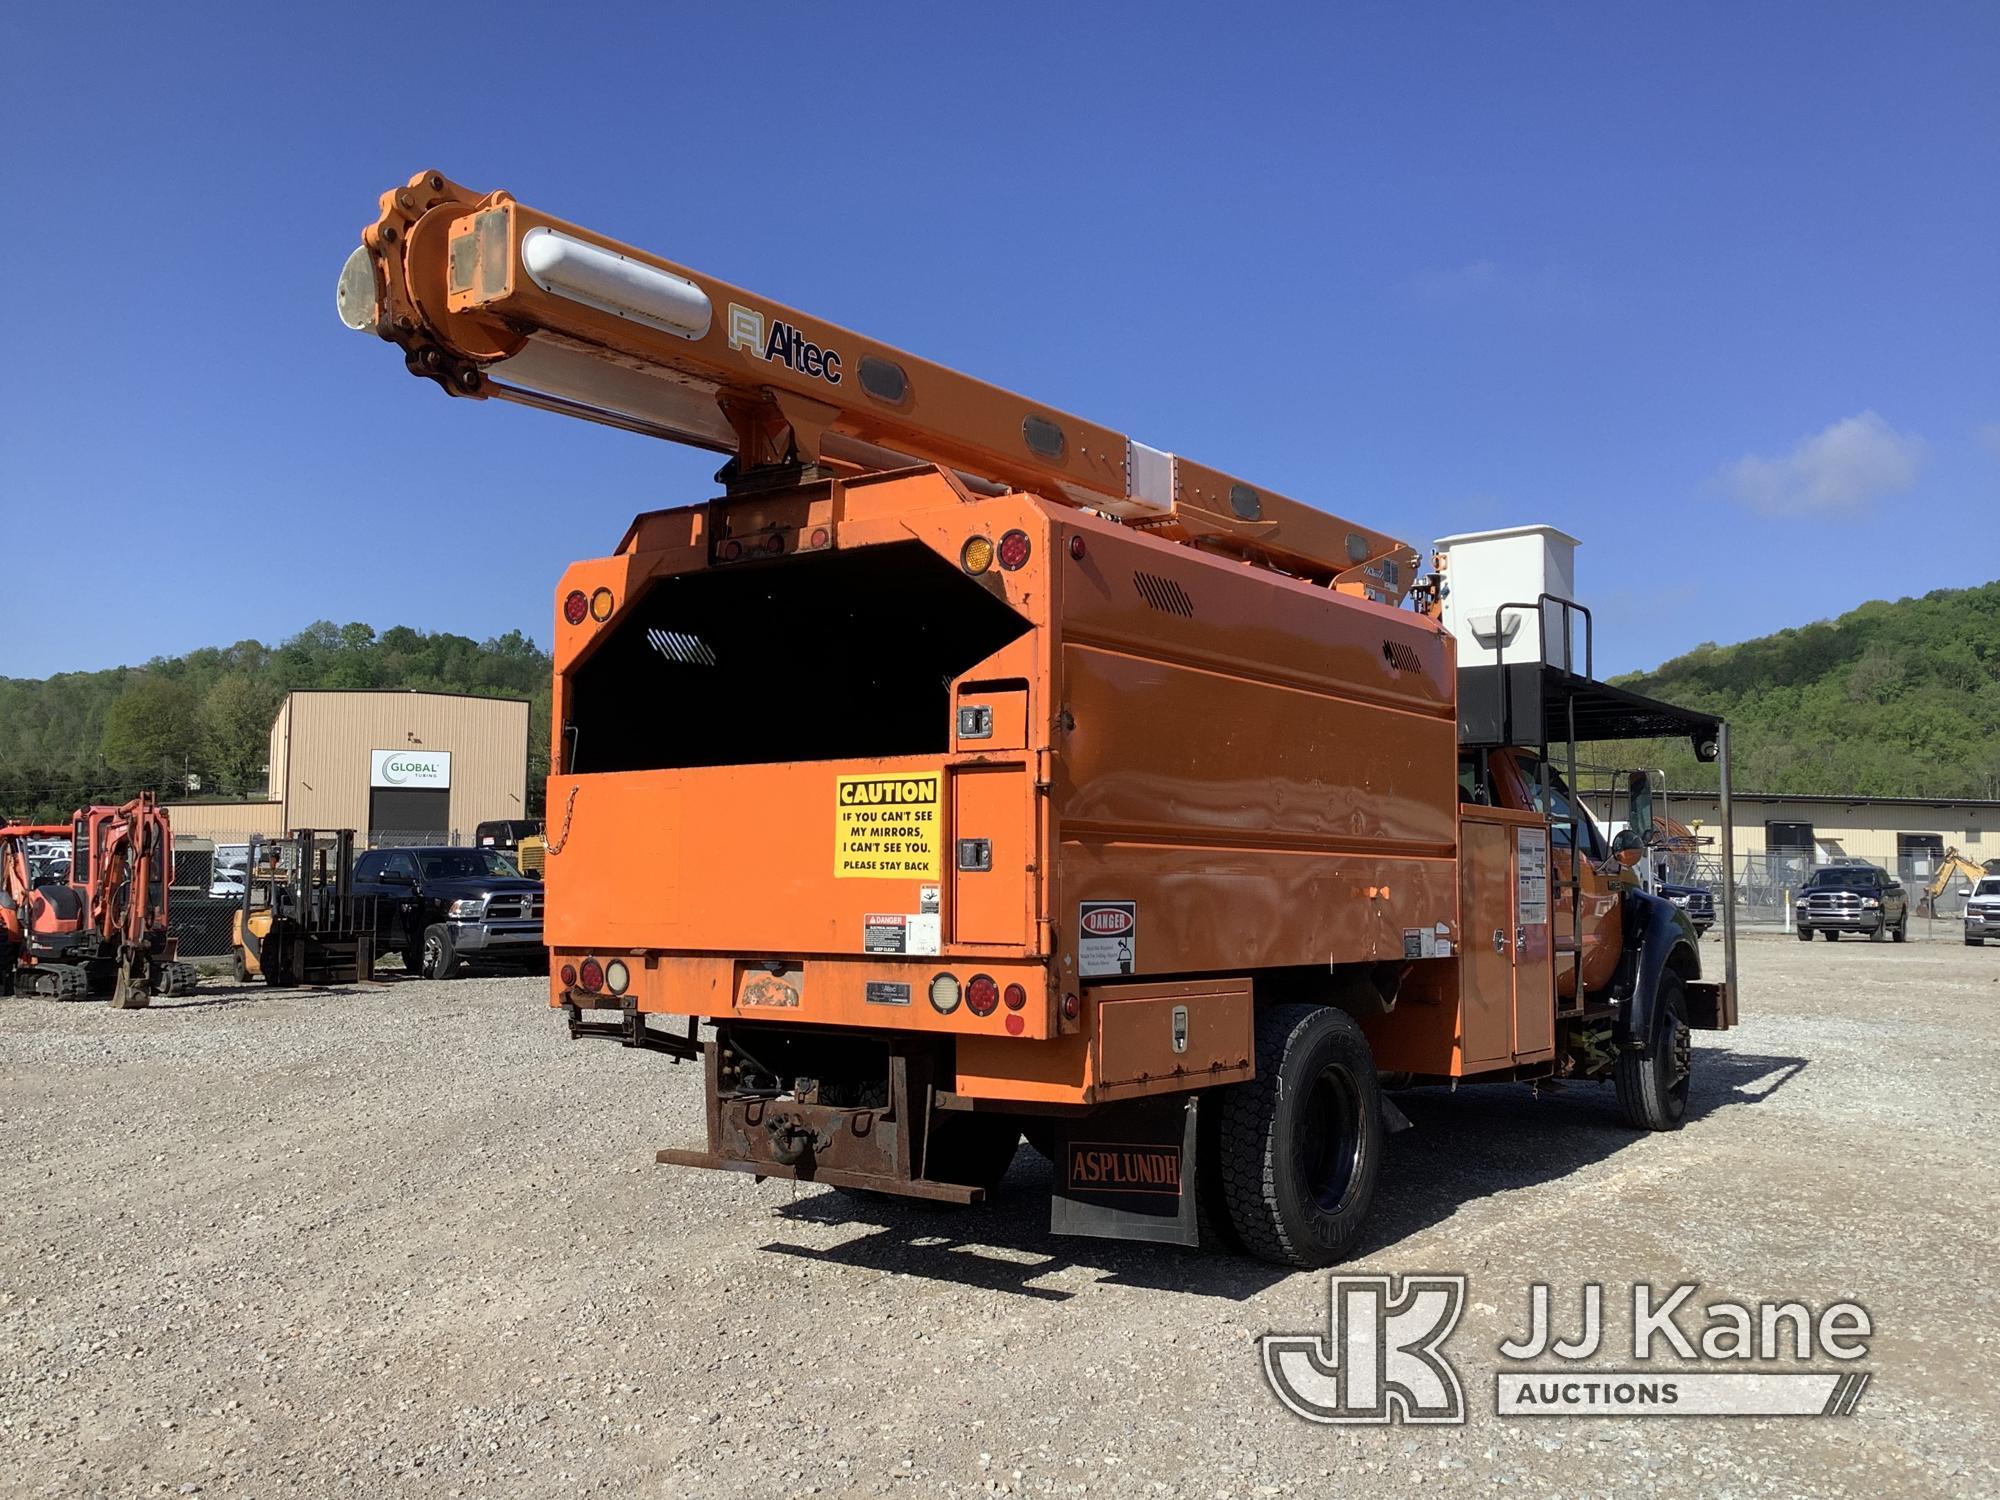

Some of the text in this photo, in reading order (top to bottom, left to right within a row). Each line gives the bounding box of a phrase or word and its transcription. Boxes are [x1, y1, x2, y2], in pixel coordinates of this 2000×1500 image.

[764, 319, 842, 384] Altec
[391, 763, 438, 772] GLOBAL
[841, 781, 934, 804] CAUTION
[843, 811, 933, 822] IF YOU CAN'T SEE
[851, 827, 924, 839] MY MIRRORS,
[843, 842, 931, 853] I CAN'T SEE YOU.
[844, 861, 929, 871] PLEASE STAY BACK
[876, 916, 902, 924] DANGER
[1090, 913, 1126, 929] DANGER
[1072, 1151, 1178, 1184] ASPLUNDH
